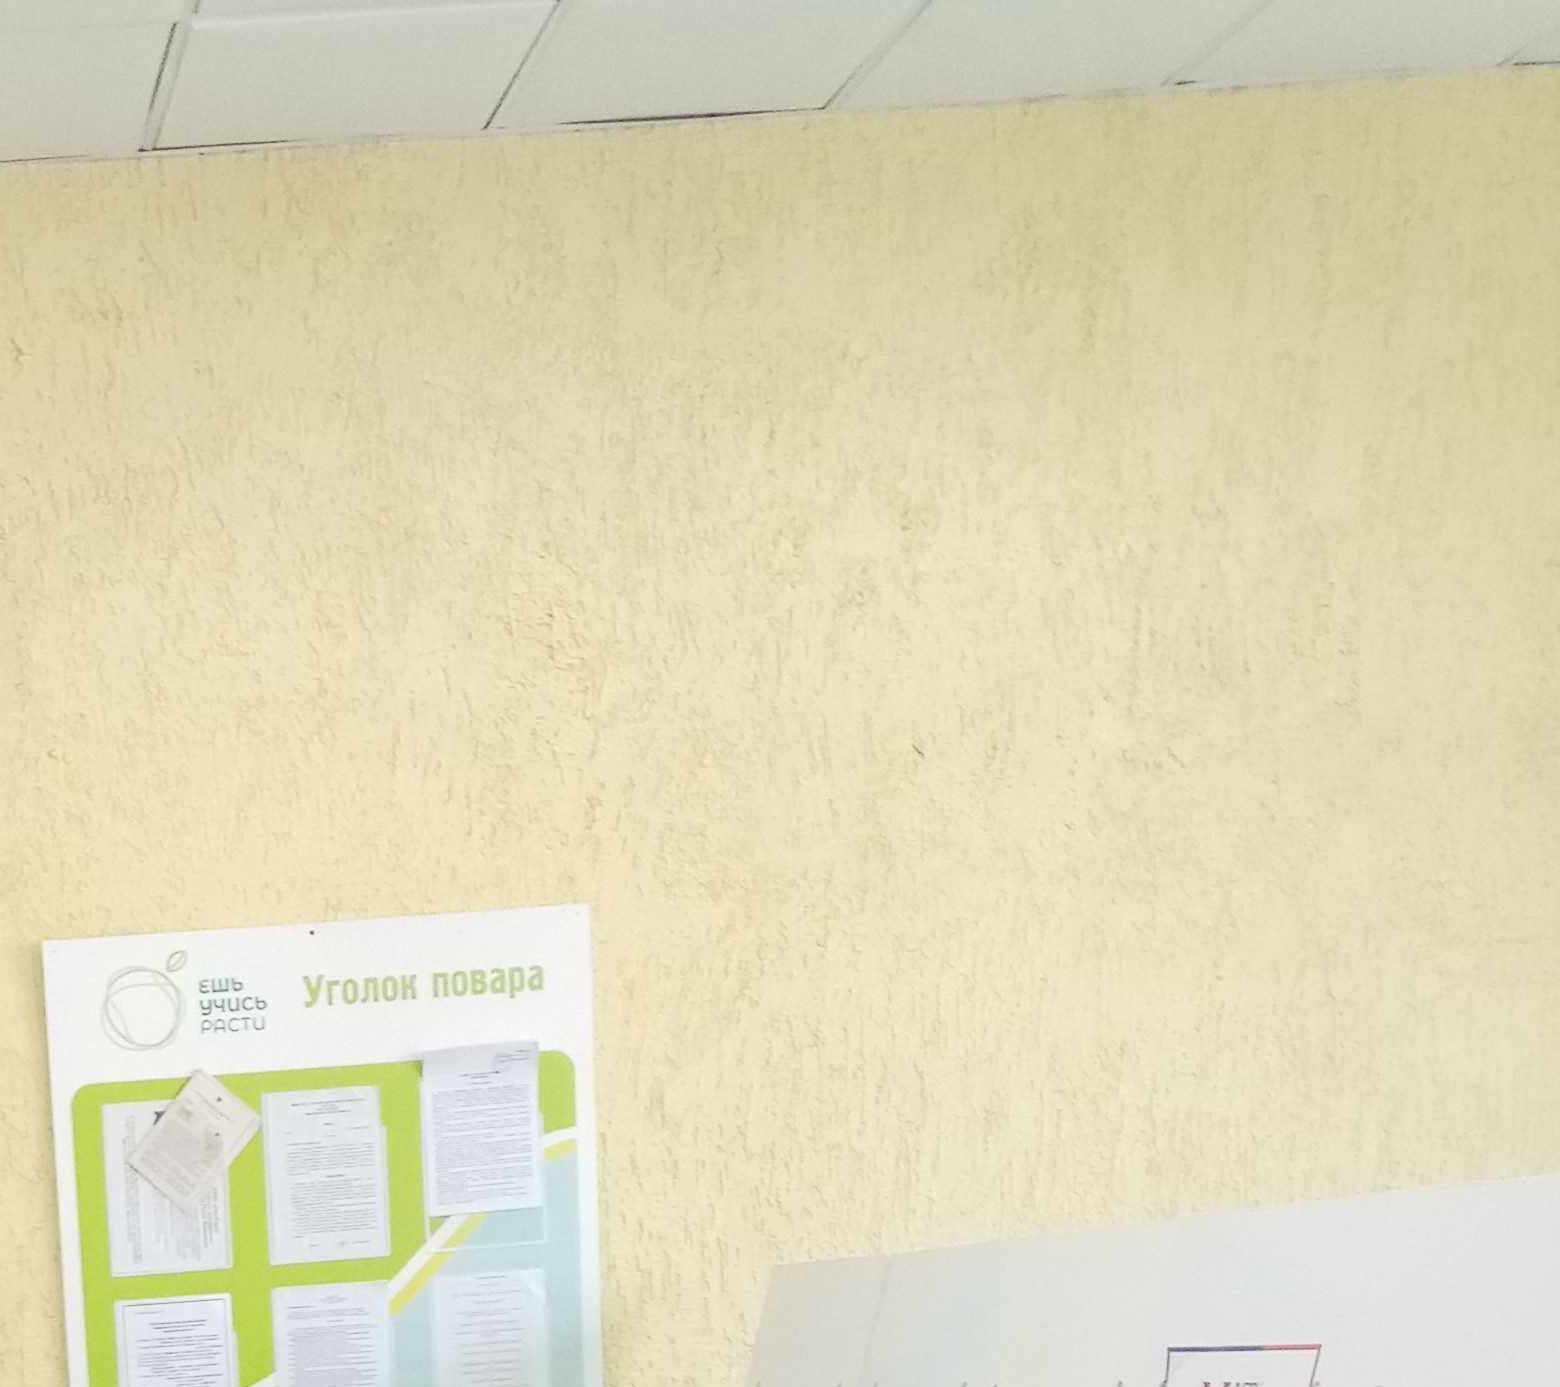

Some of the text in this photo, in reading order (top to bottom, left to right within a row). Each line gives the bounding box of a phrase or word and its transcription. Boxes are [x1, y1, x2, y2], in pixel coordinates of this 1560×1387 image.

[197, 977, 244, 994] ЕШЬ
[303, 965, 546, 1008] Уголок повара
[198, 995, 268, 1016] УЧИСЬ
[199, 1015, 267, 1035] РАСТИ
